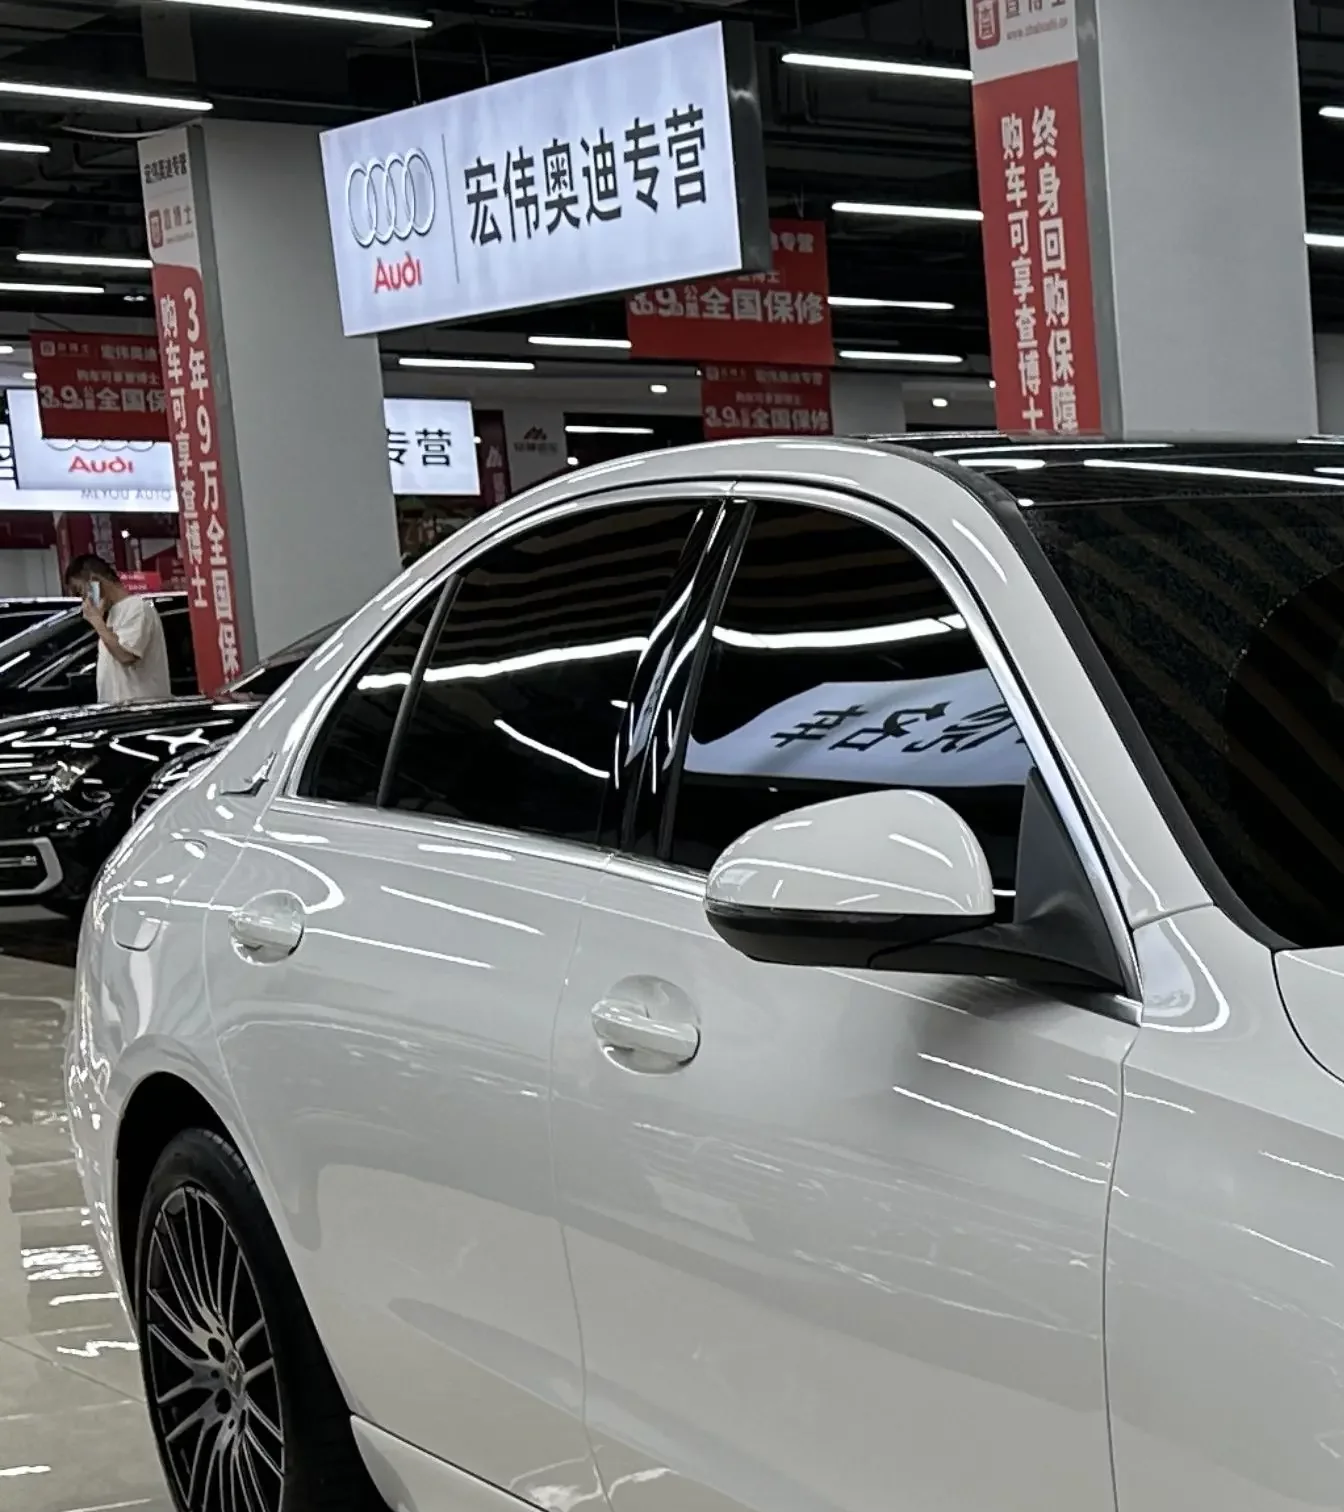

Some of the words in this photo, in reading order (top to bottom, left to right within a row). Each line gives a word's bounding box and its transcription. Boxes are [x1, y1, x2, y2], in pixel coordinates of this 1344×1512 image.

[373, 250, 423, 293] Audi
[463, 103, 707, 246] 宏伟奥迪专营
[1031, 105, 1079, 437] 终身回购保障
[68, 455, 135, 474] Audi
[159, 294, 209, 608] 购车可享查博士
[183, 287, 240, 685] 3年9万全国保
